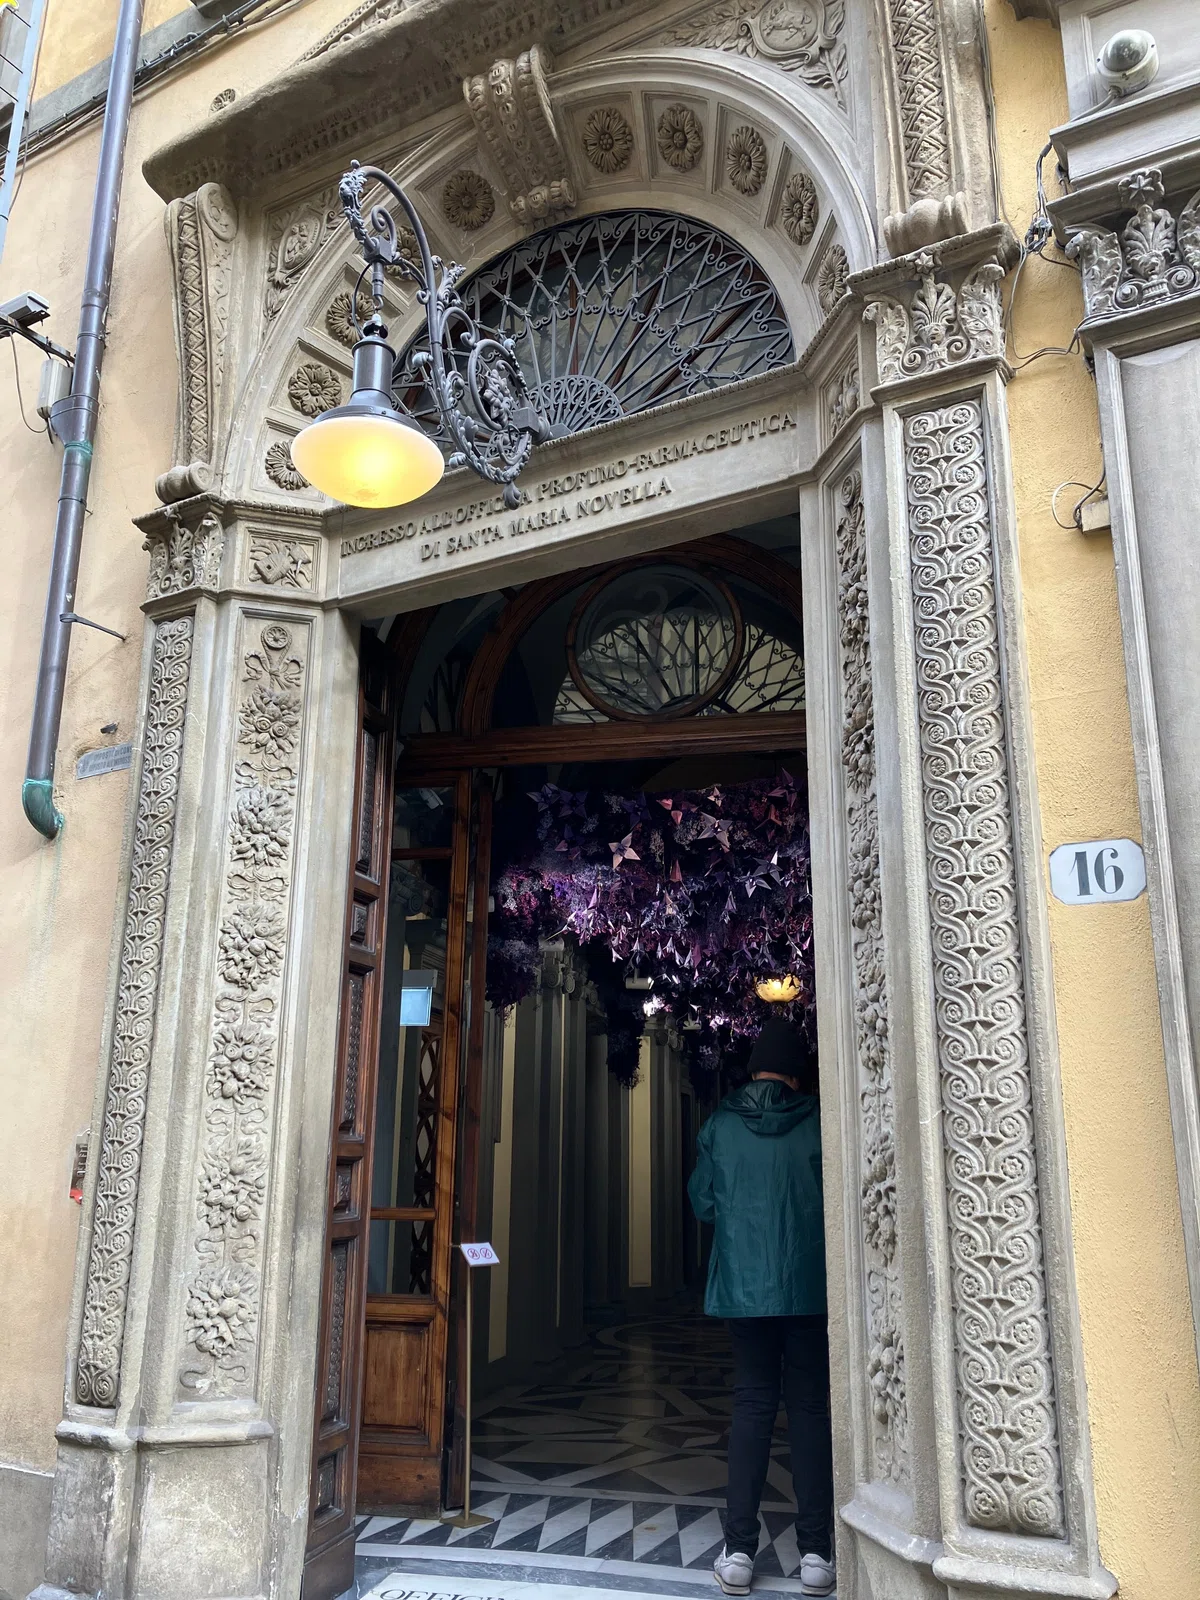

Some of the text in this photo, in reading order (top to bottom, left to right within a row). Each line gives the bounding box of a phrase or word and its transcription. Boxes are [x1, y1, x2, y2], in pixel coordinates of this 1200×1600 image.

[340, 410, 798, 558] INGRESSO ALL'OFFICA PROFUMO-FARMACEUTICA
[421, 476, 673, 561] DI SANTA MARIA NOVELLA
[1069, 848, 1124, 896] 16
